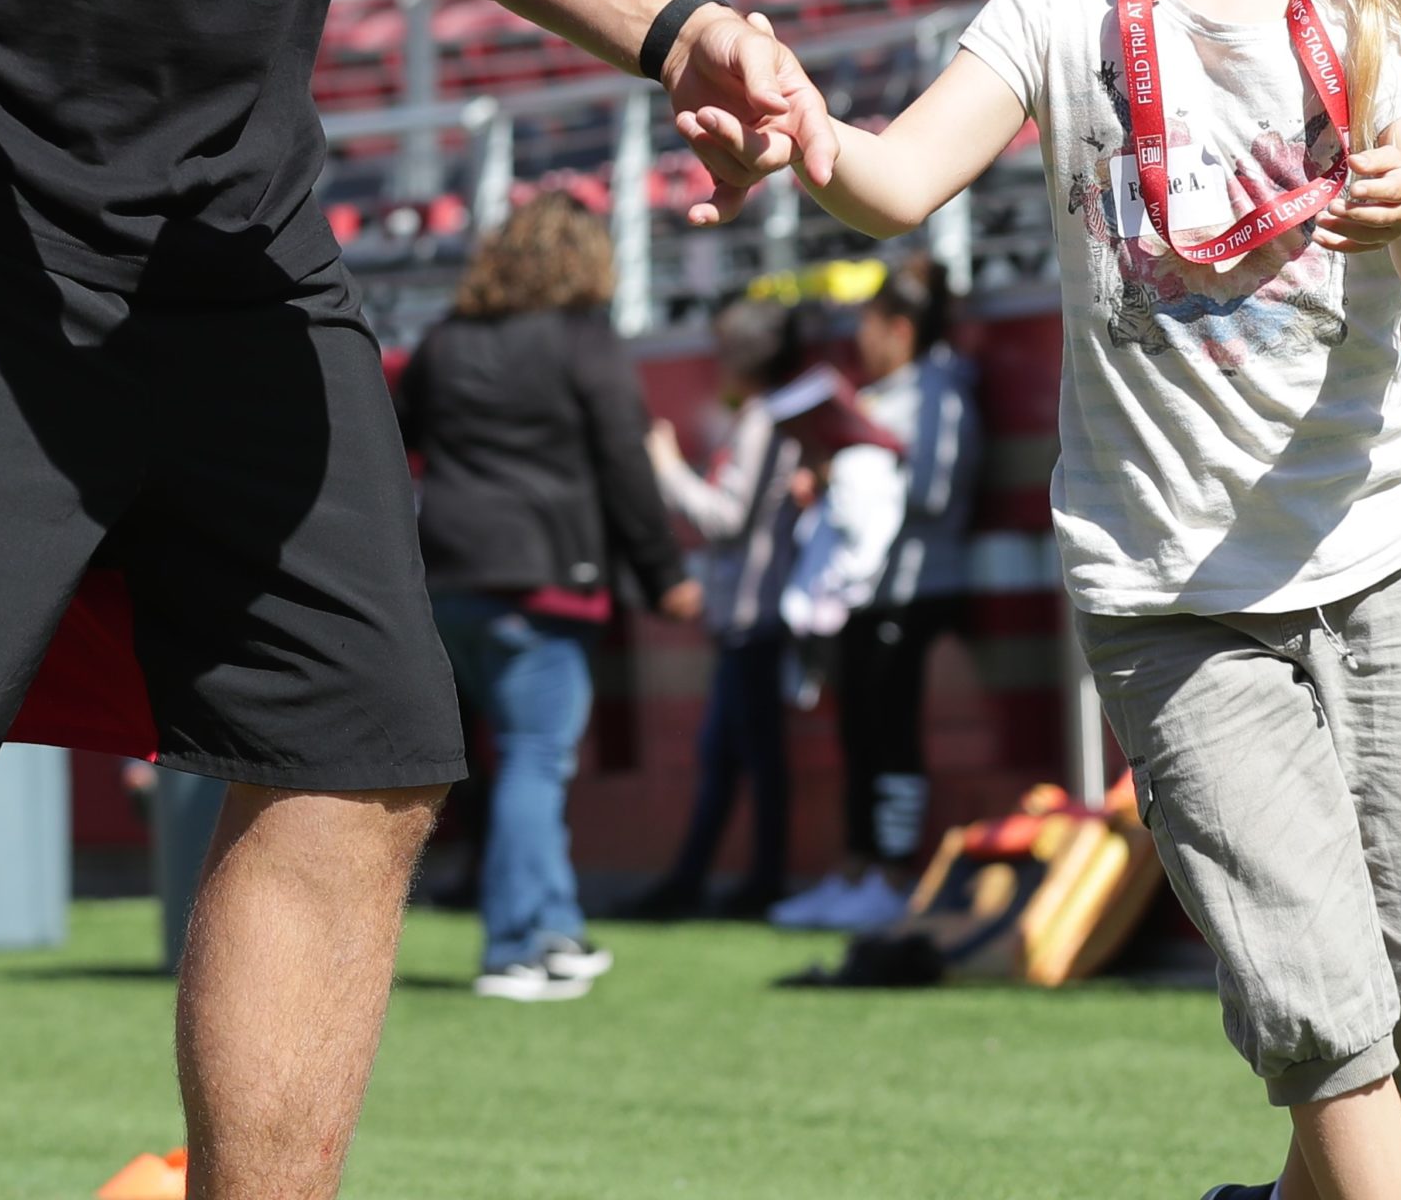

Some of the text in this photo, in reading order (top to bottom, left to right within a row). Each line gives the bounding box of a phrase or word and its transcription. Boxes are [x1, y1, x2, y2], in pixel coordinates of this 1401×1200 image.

[1127, 2, 1144, 19] AT
[1129, 23, 1148, 57] TRIP
[1301, 26, 1341, 95] STADIUM
[1134, 59, 1152, 104] FIELD
[1141, 146, 1161, 164] EDU
[1189, 172, 1205, 192] A.
[1183, 242, 1226, 259] FIELD
[1226, 224, 1253, 250] TRIP
[1256, 211, 1275, 233] AT
